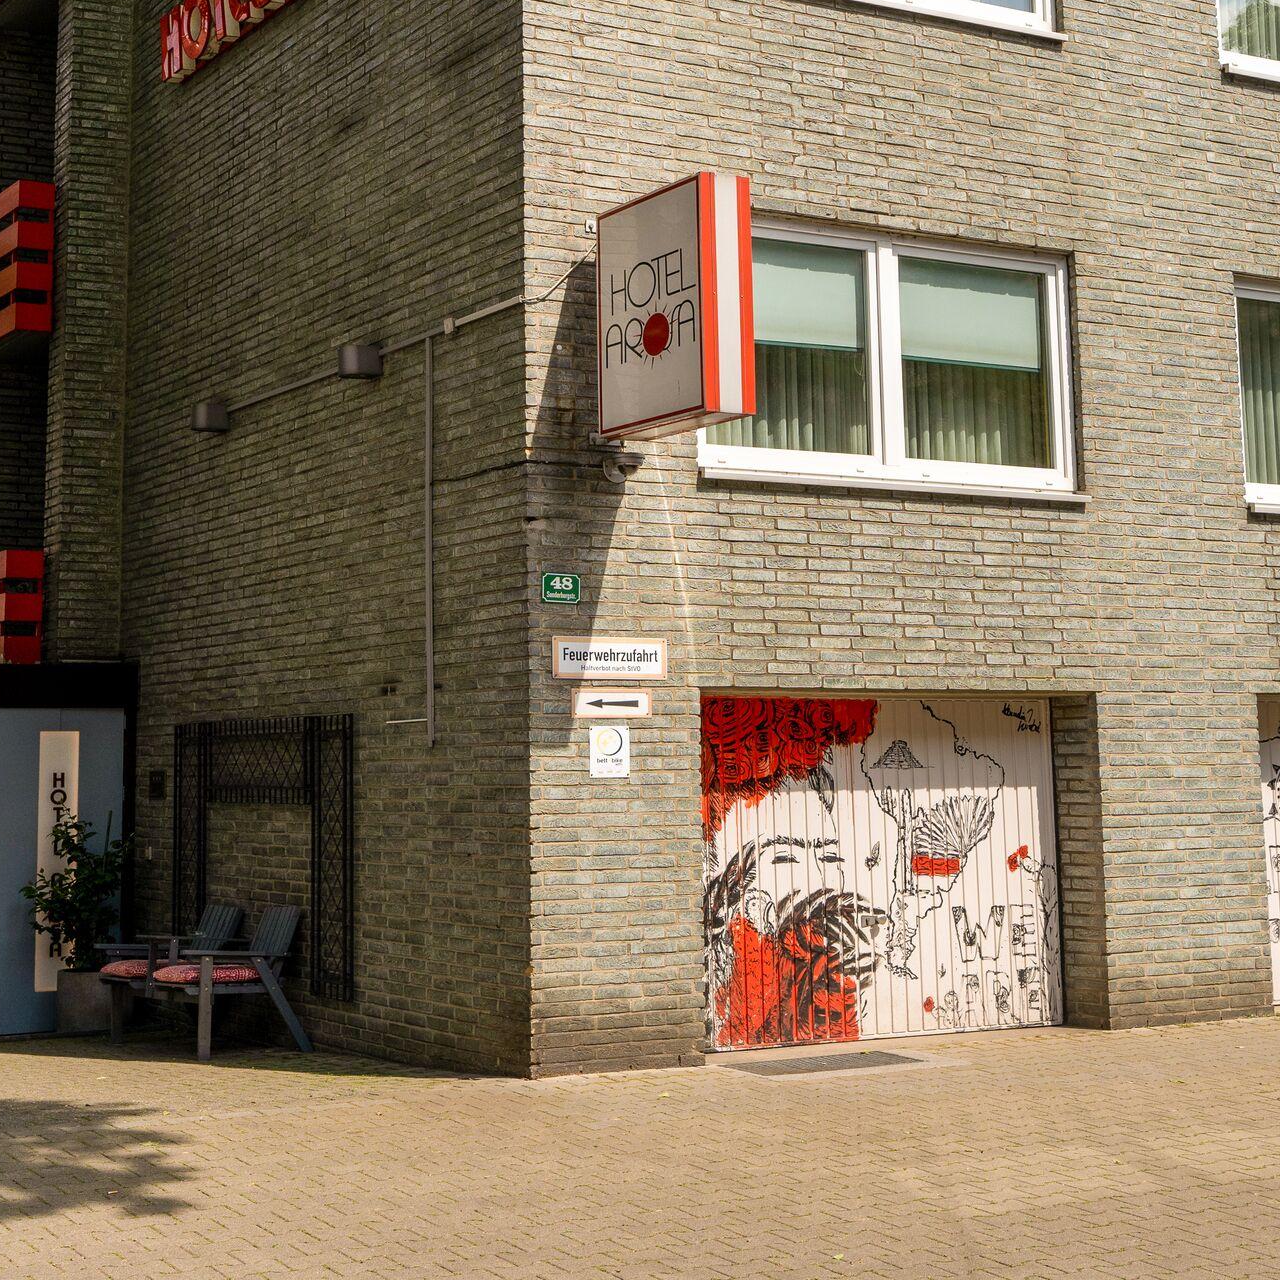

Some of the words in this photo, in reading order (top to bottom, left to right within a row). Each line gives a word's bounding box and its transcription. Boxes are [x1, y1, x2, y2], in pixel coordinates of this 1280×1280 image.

[610, 248, 697, 316] HOTEL
[550, 576, 573, 590] 48
[563, 647, 658, 663] Feuerwehrzufahrt
[50, 772, 67, 856] HOTL
